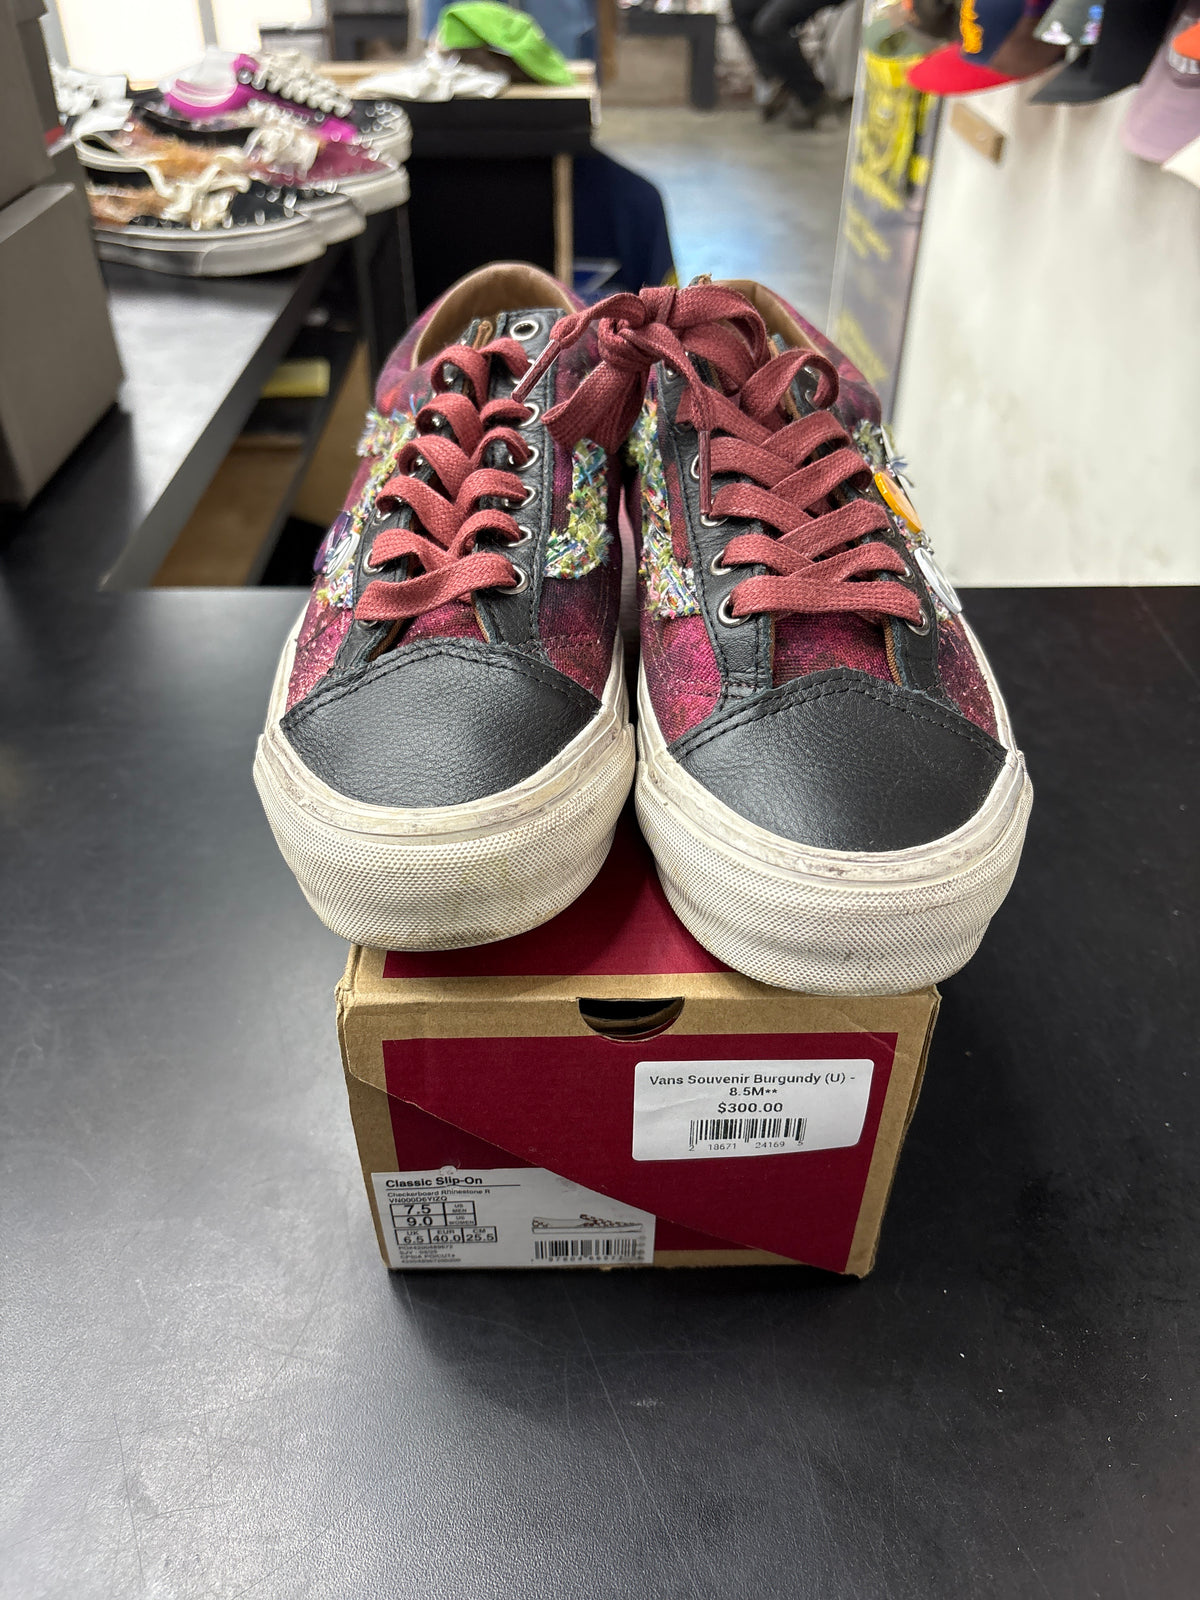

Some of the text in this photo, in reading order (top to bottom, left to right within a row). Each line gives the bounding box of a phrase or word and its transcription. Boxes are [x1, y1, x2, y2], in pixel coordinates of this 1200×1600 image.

[649, 1075, 684, 1086] Vans
[687, 1073, 750, 1085] Souvenir
[754, 1072, 821, 1085] Burgundy
[825, 1072, 846, 1083] (U)
[717, 1101, 783, 1114] $300.00
[708, 1143, 737, 1151] 18671
[755, 1141, 785, 1149] 24169
[386, 1176, 483, 1188] Classic Slip-On
[387, 1190, 439, 1198] Checkerboard
[441, 1188, 482, 1196] Rhinestone
[404, 1204, 432, 1215] 7.5
[406, 1216, 433, 1227] 9.0
[403, 1235, 425, 1244] 6.5
[433, 1234, 462, 1243] 40.0
[466, 1233, 495, 1242] 25.5
